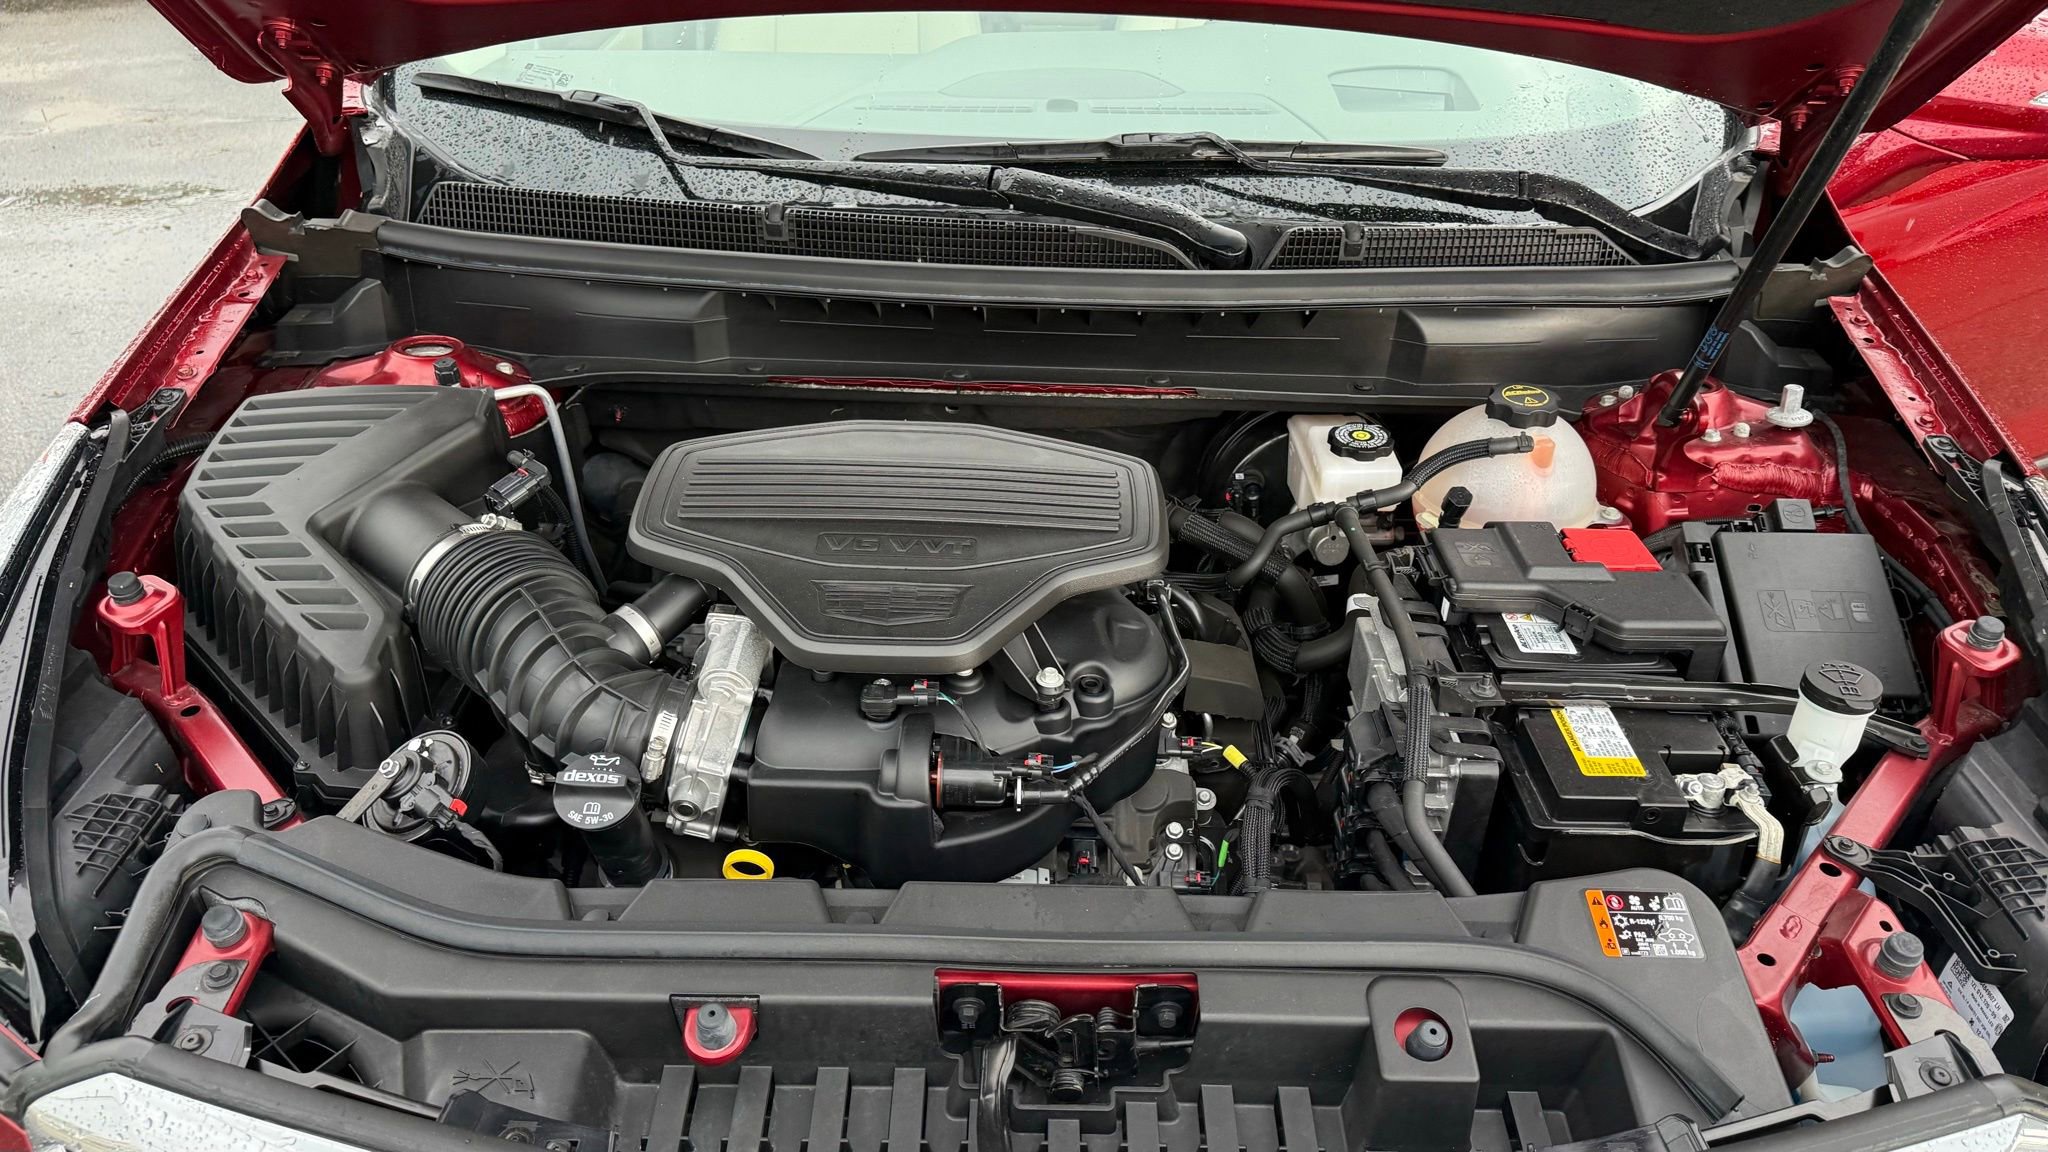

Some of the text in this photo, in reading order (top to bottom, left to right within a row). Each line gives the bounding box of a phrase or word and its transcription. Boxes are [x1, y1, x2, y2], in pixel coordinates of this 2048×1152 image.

[824, 536, 972, 554] V6 VVT
[563, 770, 621, 784] dexos
[568, 810, 614, 824] SAE 5W-30
